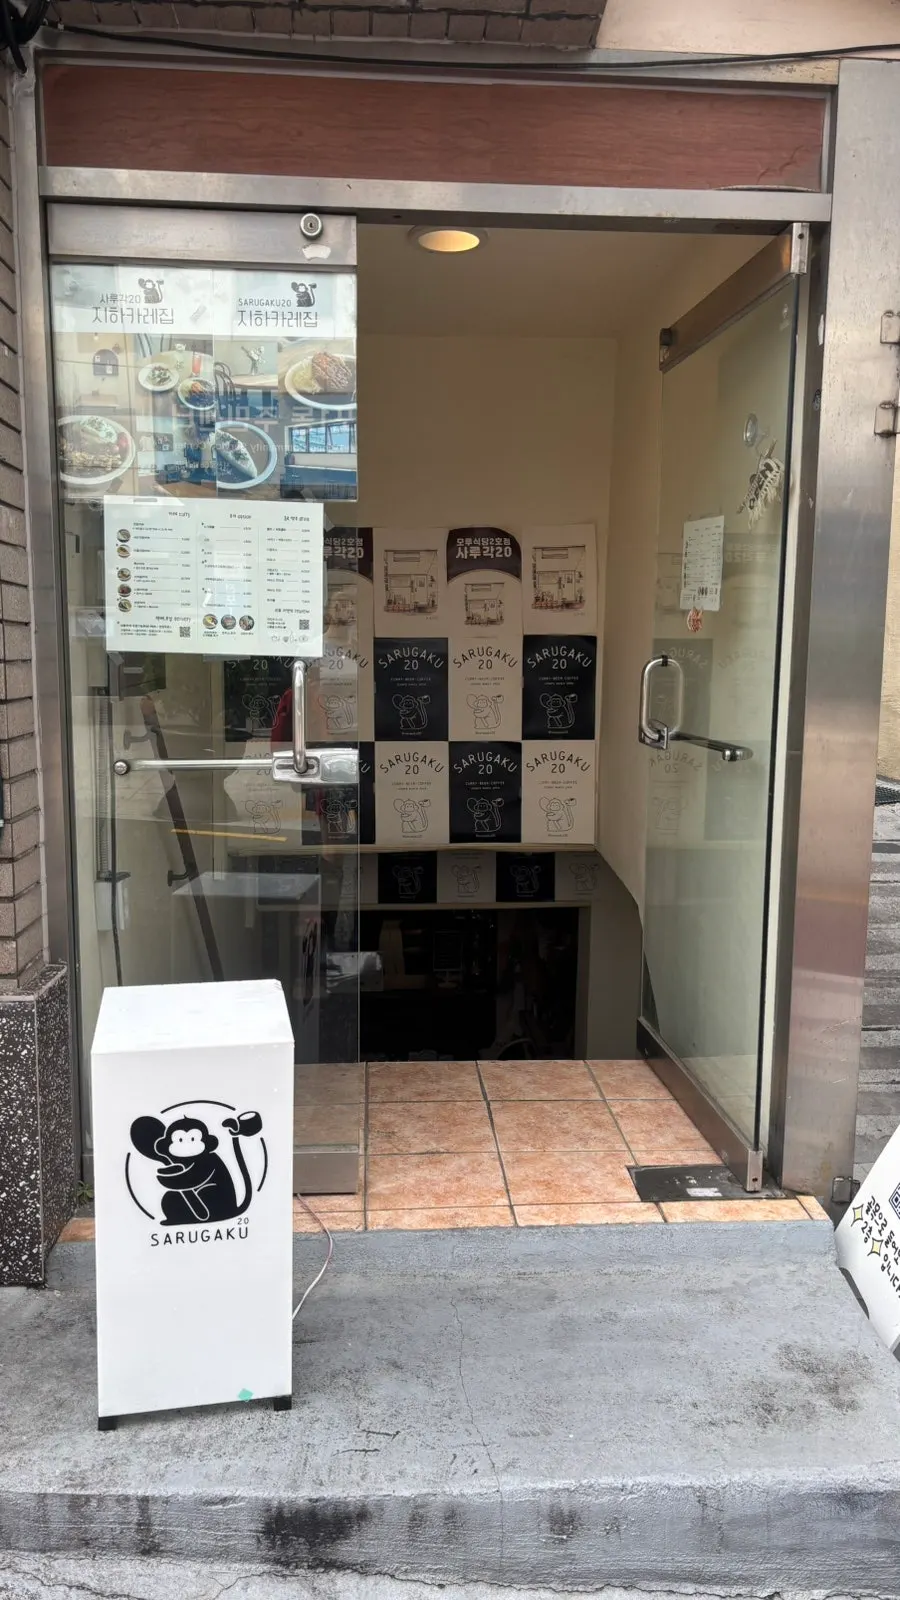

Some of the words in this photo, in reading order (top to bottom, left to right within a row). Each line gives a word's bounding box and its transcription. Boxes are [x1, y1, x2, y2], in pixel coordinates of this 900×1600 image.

[99, 293, 141, 304] 사루각20
[238, 298, 292, 307] SARUGAKU20
[92, 306, 175, 325] 지하카레집
[237, 310, 318, 328] 지하카레집
[324, 538, 363, 546] 식당2호점
[323, 546, 364, 559] 루각20
[456, 546, 512, 559] 사루각20
[378, 646, 444, 668] SARUGAKU
[453, 645, 518, 669] SARUGAKU
[527, 645, 592, 668] SARUGAKU
[253, 659, 268, 670] 20
[328, 660, 344, 670] 20
[404, 659, 419, 670] 20
[478, 659, 493, 670] 20
[552, 658, 567, 669] 20
[380, 752, 445, 774] SARUGAKU
[453, 751, 517, 774] SARUGAKU
[526, 750, 591, 772] SARUGAKU
[405, 764, 419, 775] 20
[478, 764, 493, 774] 20
[551, 763, 566, 774] 20
[237, 1217, 250, 1225] 20
[865, 1195, 888, 1237] 골목으로
[150, 1226, 249, 1247] SARUGAKU
[861, 1220, 873, 1244] 2층
